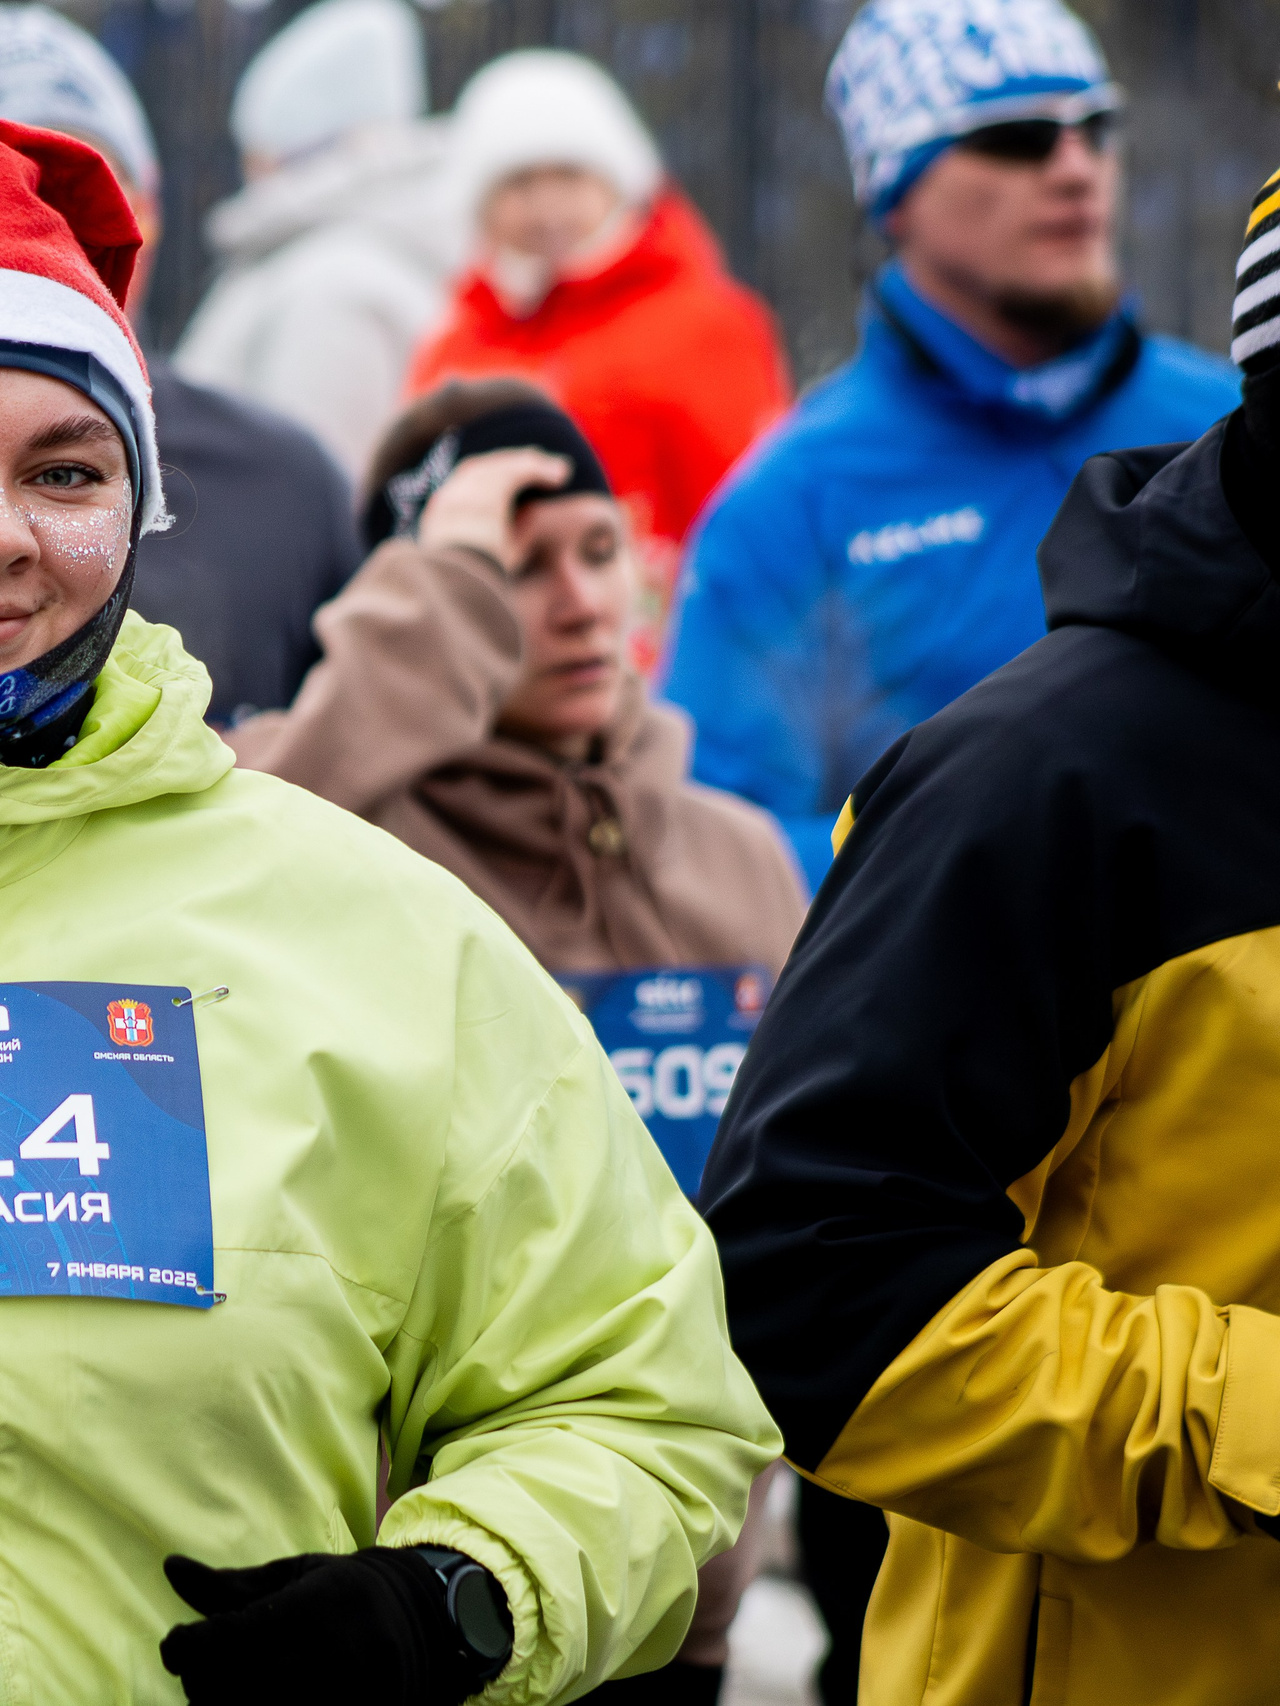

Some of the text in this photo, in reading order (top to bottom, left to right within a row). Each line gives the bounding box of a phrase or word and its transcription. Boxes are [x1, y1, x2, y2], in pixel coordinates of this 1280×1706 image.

[93, 1052, 174, 1062] ОМСКАЯ ОБЛАСТЬ
[46, 1262, 197, 1288] 7 ЯНВАРЯ 2025
